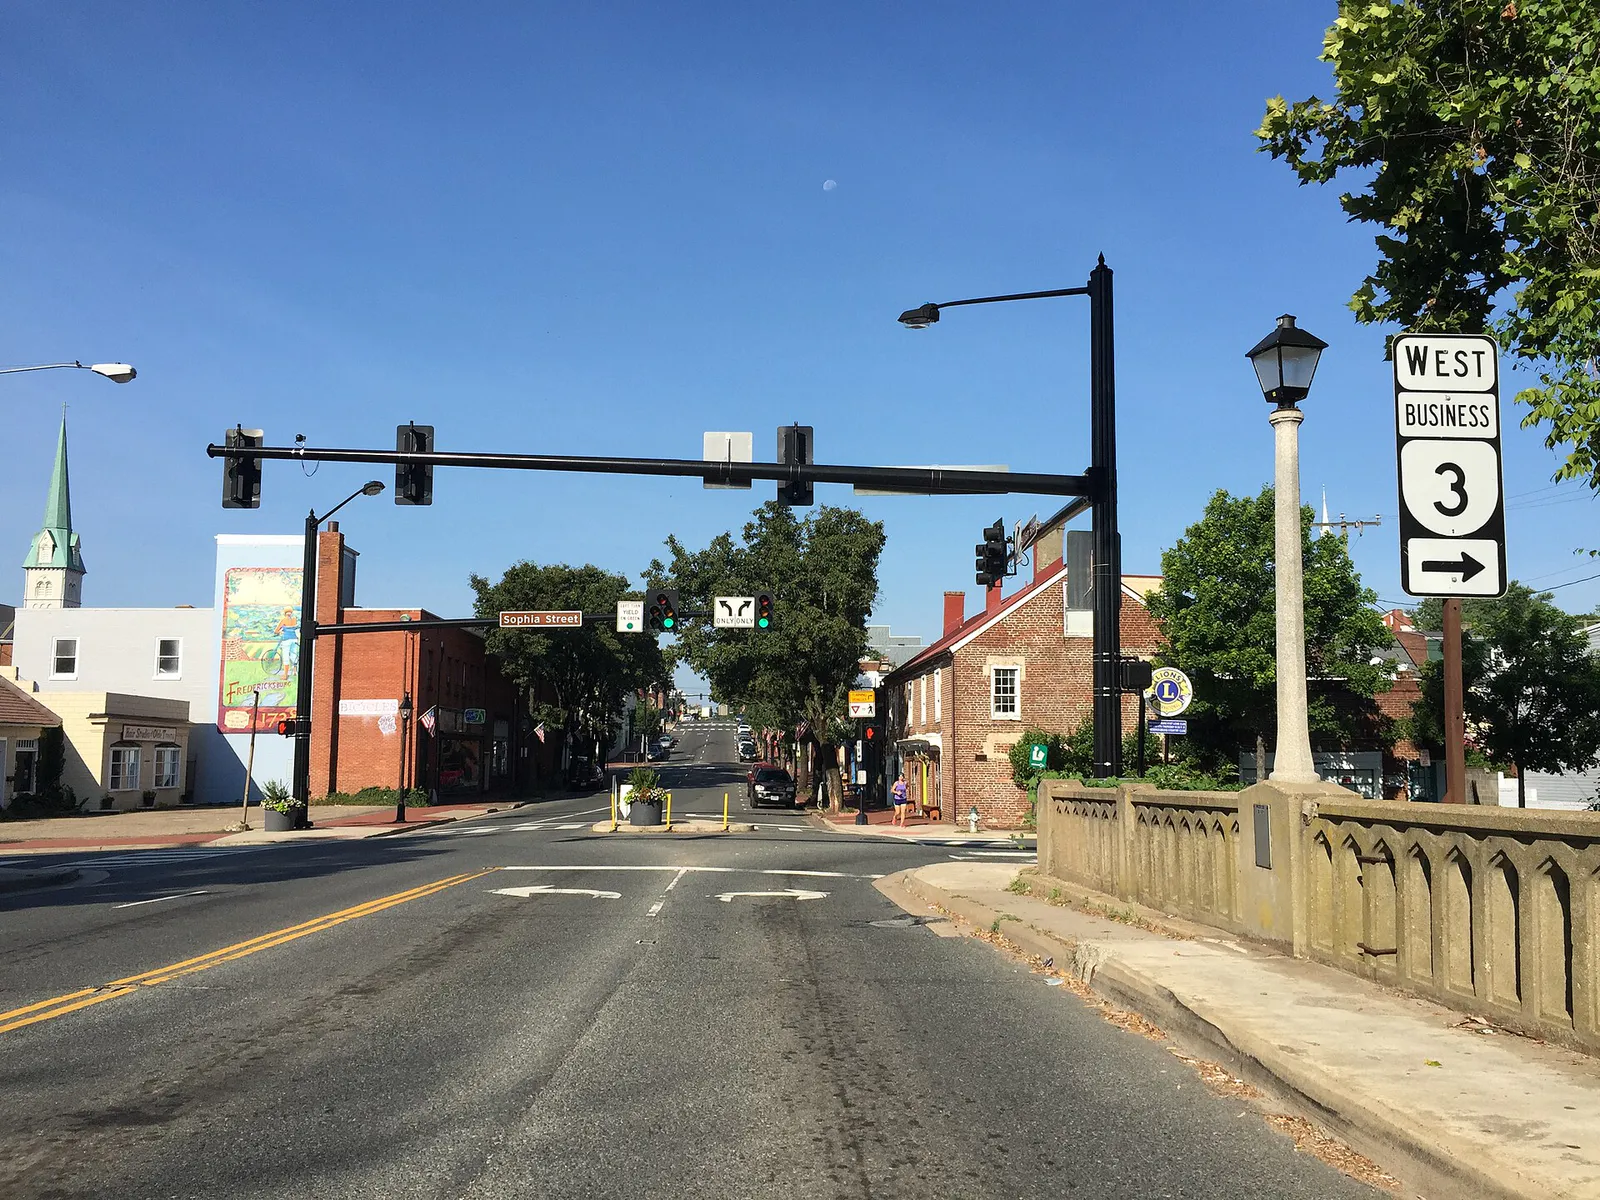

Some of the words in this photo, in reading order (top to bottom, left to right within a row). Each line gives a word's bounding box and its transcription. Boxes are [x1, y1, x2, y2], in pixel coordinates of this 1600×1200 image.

[1405, 345, 1485, 378] WEST
[1405, 403, 1490, 428] BUSINESS
[1433, 462, 1469, 517] 3
[503, 614, 541, 626] Sophia
[545, 614, 579, 624] Street
[1155, 671, 1182, 681] LIONS
[1162, 683, 1175, 699] L
[340, 701, 398, 712] BICYCLES
